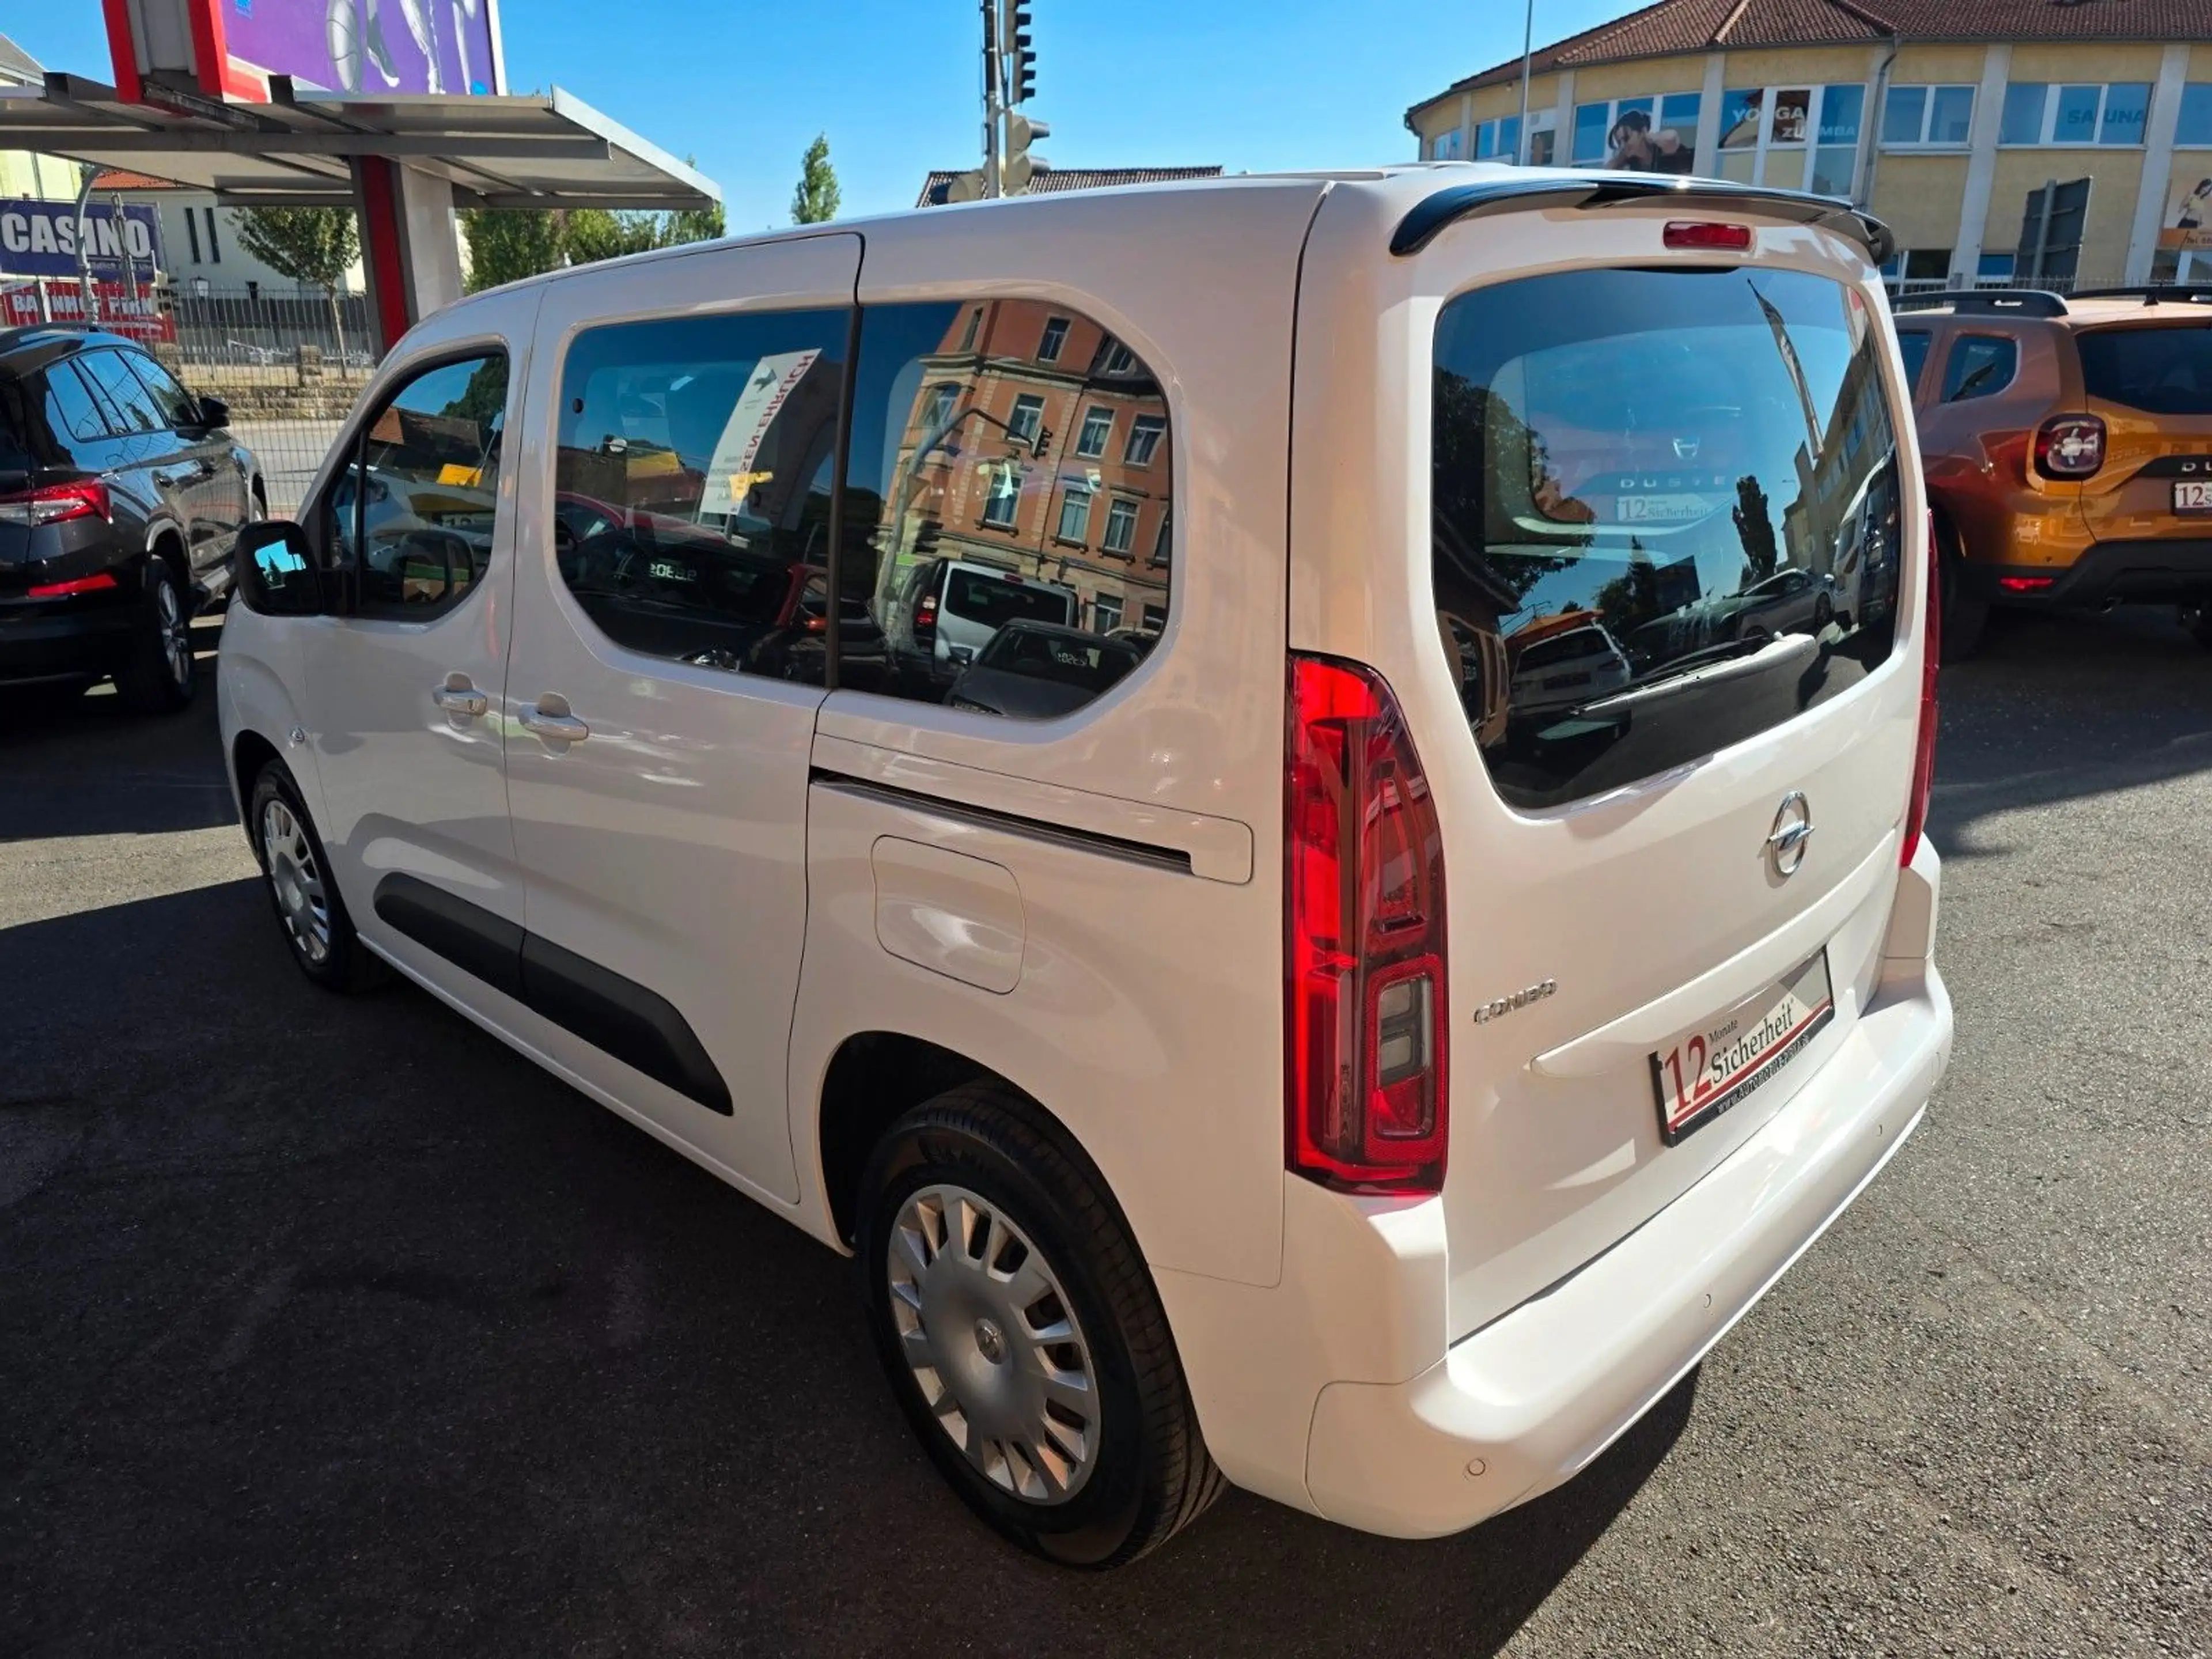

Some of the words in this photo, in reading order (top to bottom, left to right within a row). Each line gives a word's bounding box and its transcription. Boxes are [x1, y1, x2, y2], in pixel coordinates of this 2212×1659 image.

[1732, 106, 1805, 123] YOGA
[2067, 108, 2145, 124] SAUNA
[1, 212, 151, 258] CASINO
[2178, 485, 2204, 506] 12
[1621, 499, 1647, 520] 12
[1473, 978, 1558, 1025] COMBO
[1665, 1035, 1713, 1114] 12
